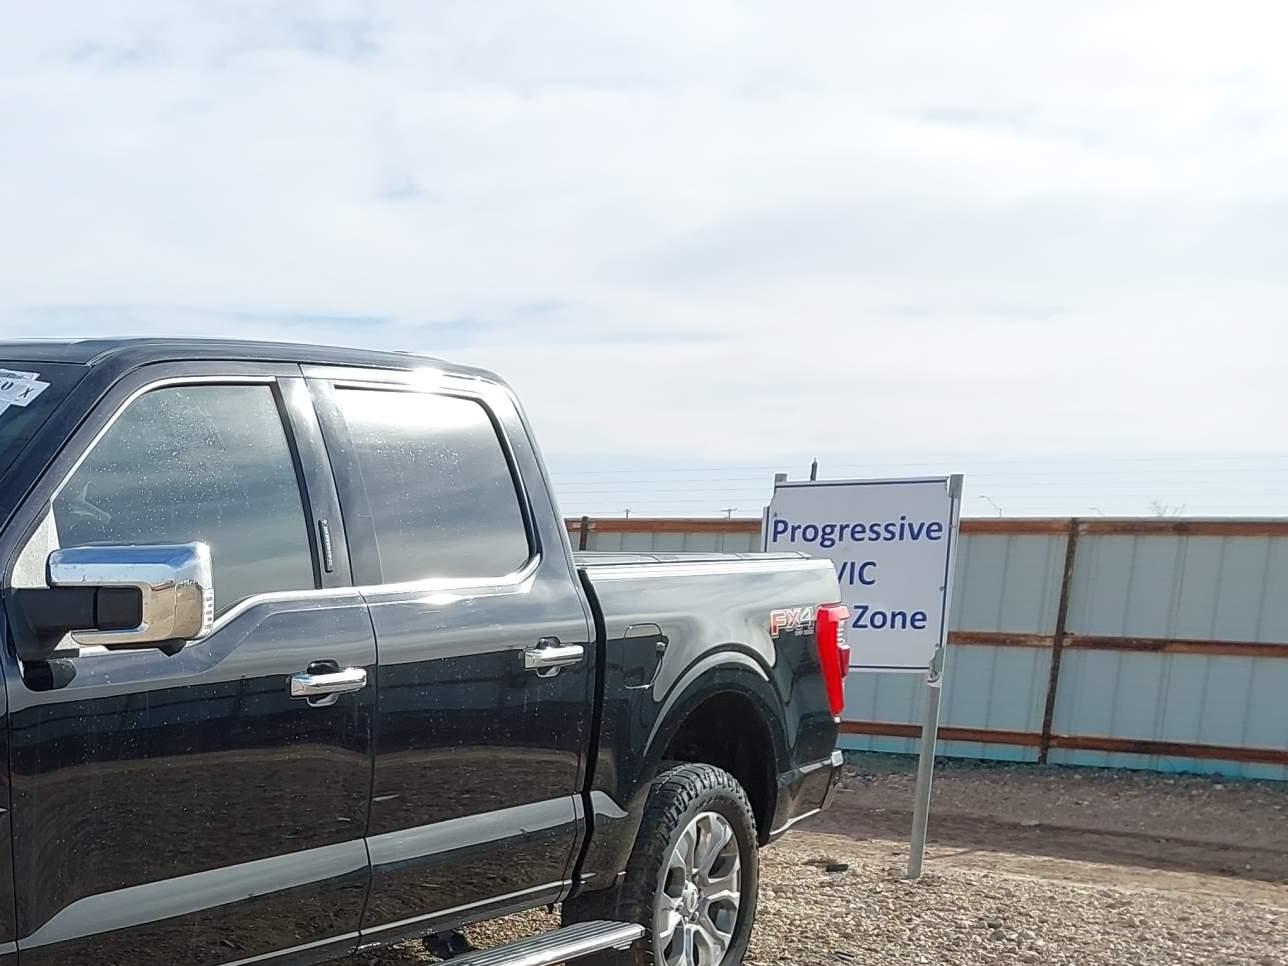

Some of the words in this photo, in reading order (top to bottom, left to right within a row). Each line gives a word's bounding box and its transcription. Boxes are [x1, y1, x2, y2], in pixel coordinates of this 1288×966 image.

[772, 515, 944, 548] Progressive
[770, 607, 815, 638] FX4
[851, 605, 928, 630] Zone
